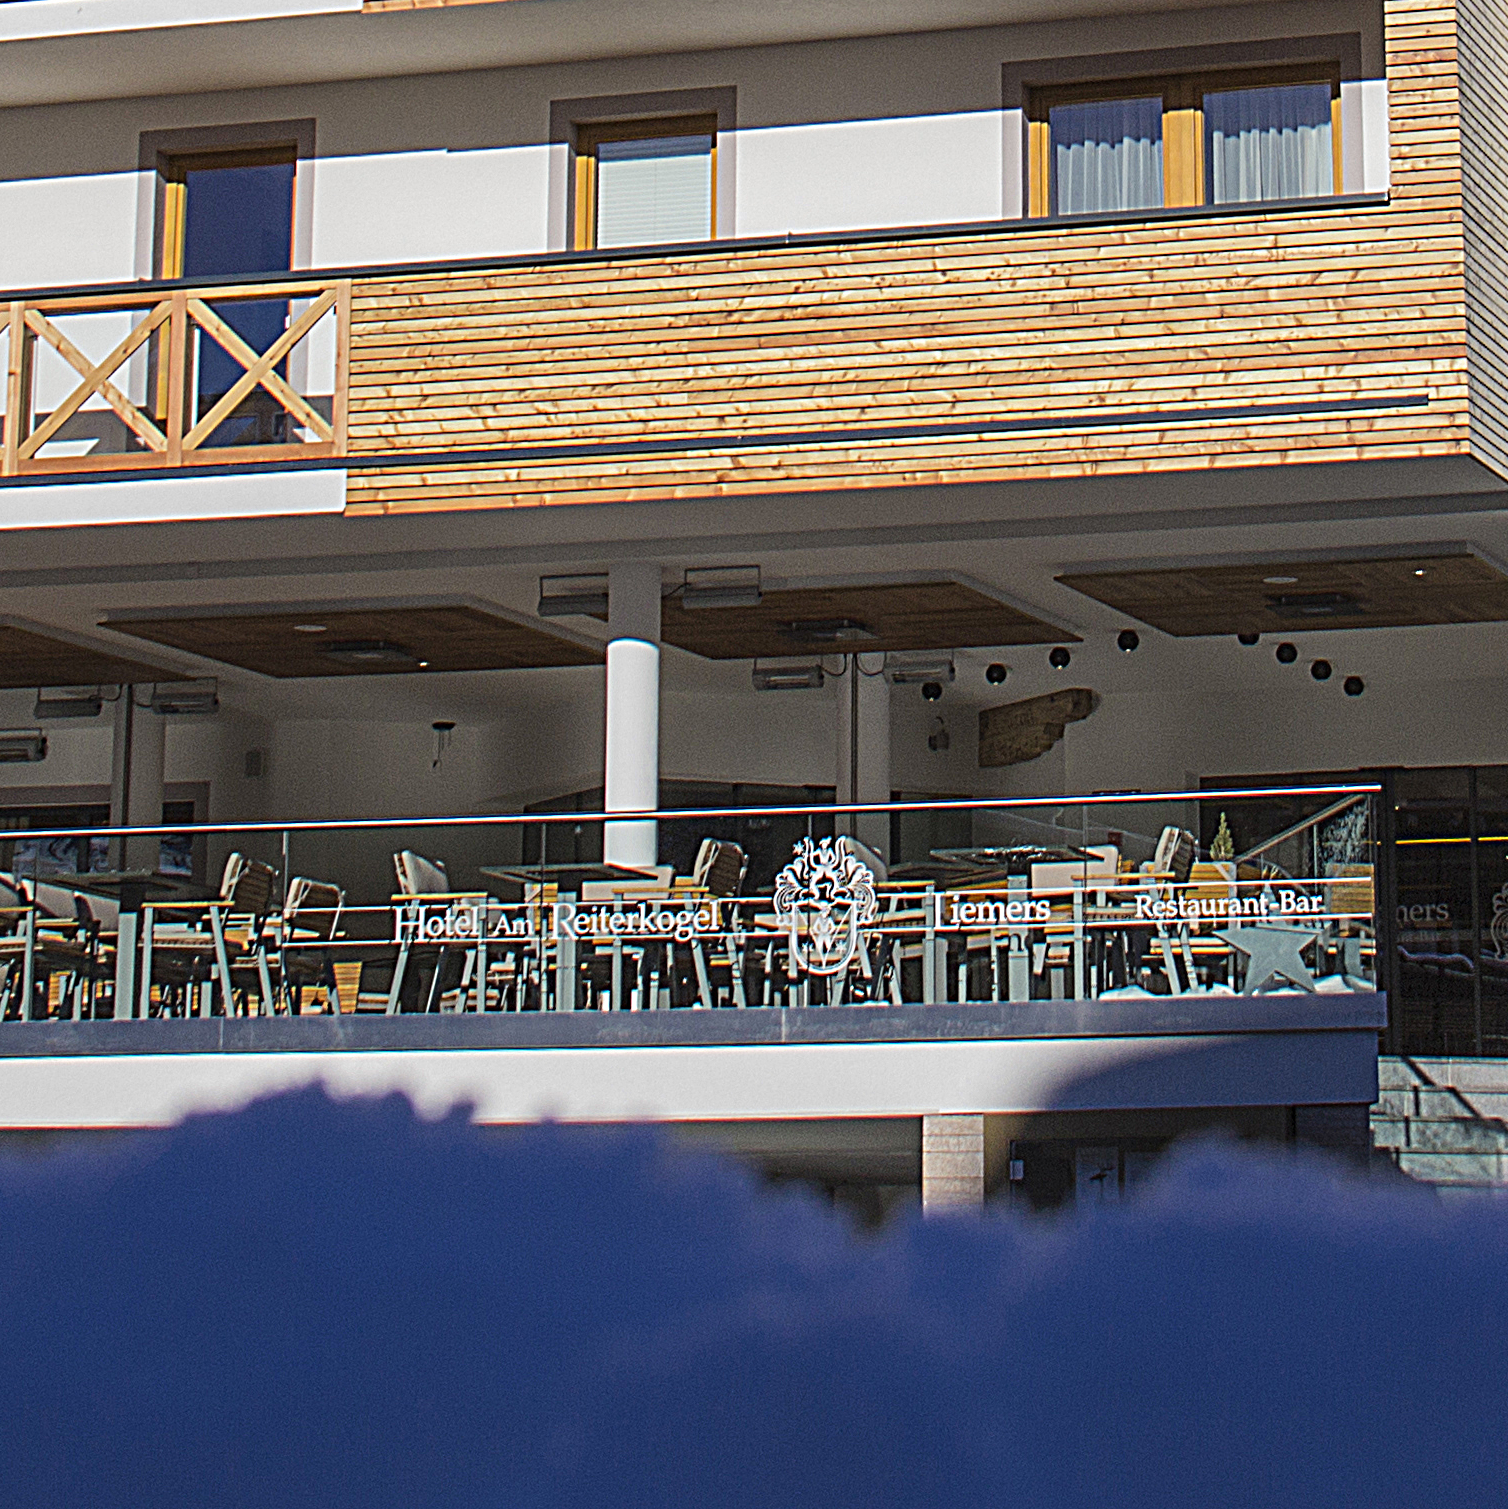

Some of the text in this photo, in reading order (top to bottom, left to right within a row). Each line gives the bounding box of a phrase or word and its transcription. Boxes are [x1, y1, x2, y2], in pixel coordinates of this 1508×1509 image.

[393, 899, 719, 942] Hotel Am Reiterkogel
[933, 889, 1323, 931] Liemers Restaurant-Bar
